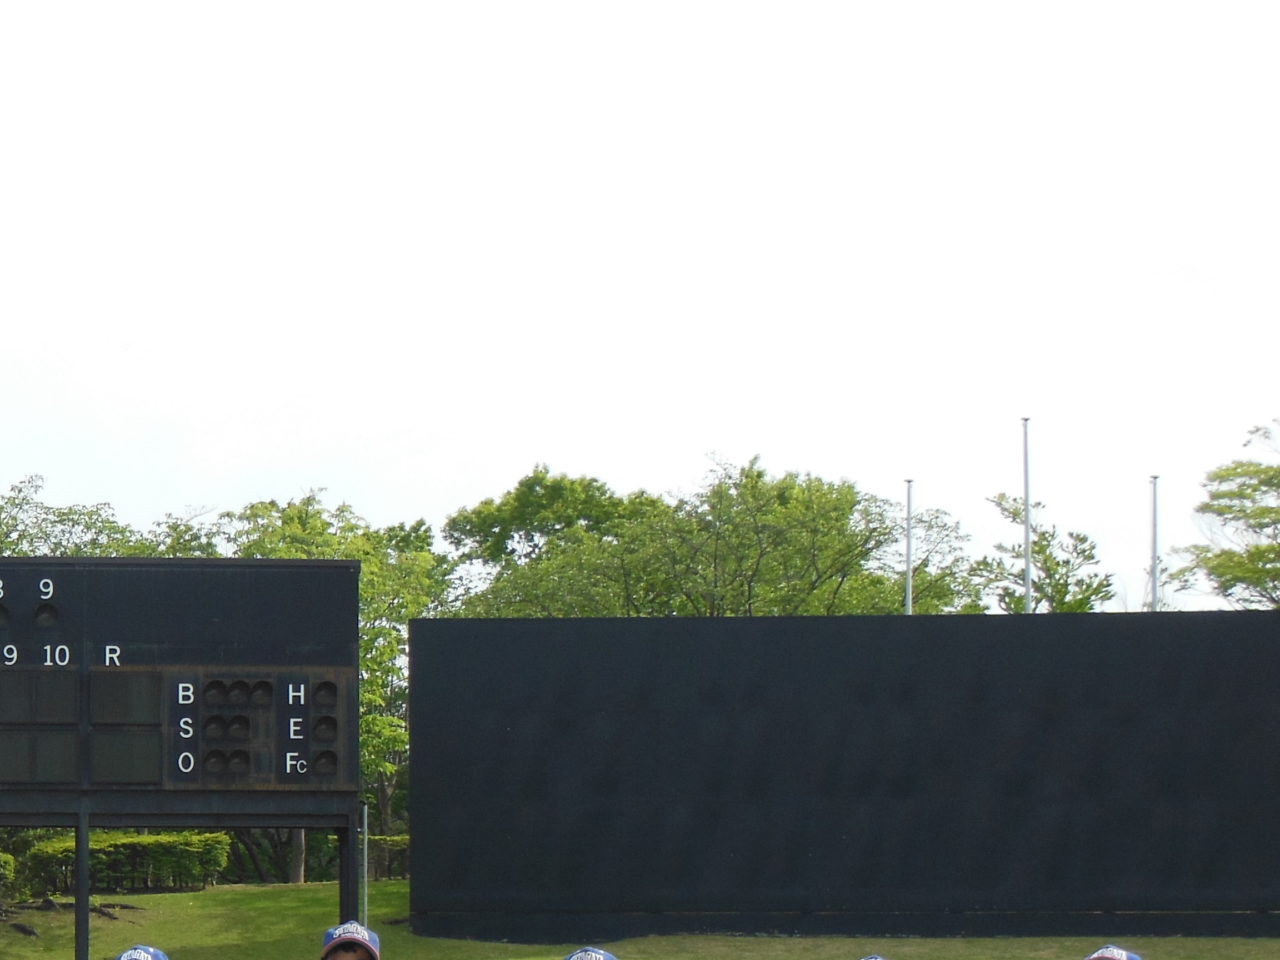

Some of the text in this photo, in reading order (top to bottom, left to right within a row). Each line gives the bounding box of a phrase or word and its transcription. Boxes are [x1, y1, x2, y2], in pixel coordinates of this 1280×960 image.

[39, 578, 54, 600] 9
[3, 644, 18, 666] 9
[43, 644, 70, 666] 10
[105, 645, 121, 667] R
[178, 683, 195, 704] B
[288, 683, 305, 705] H
[179, 717, 194, 739] S
[289, 718, 304, 739] E
